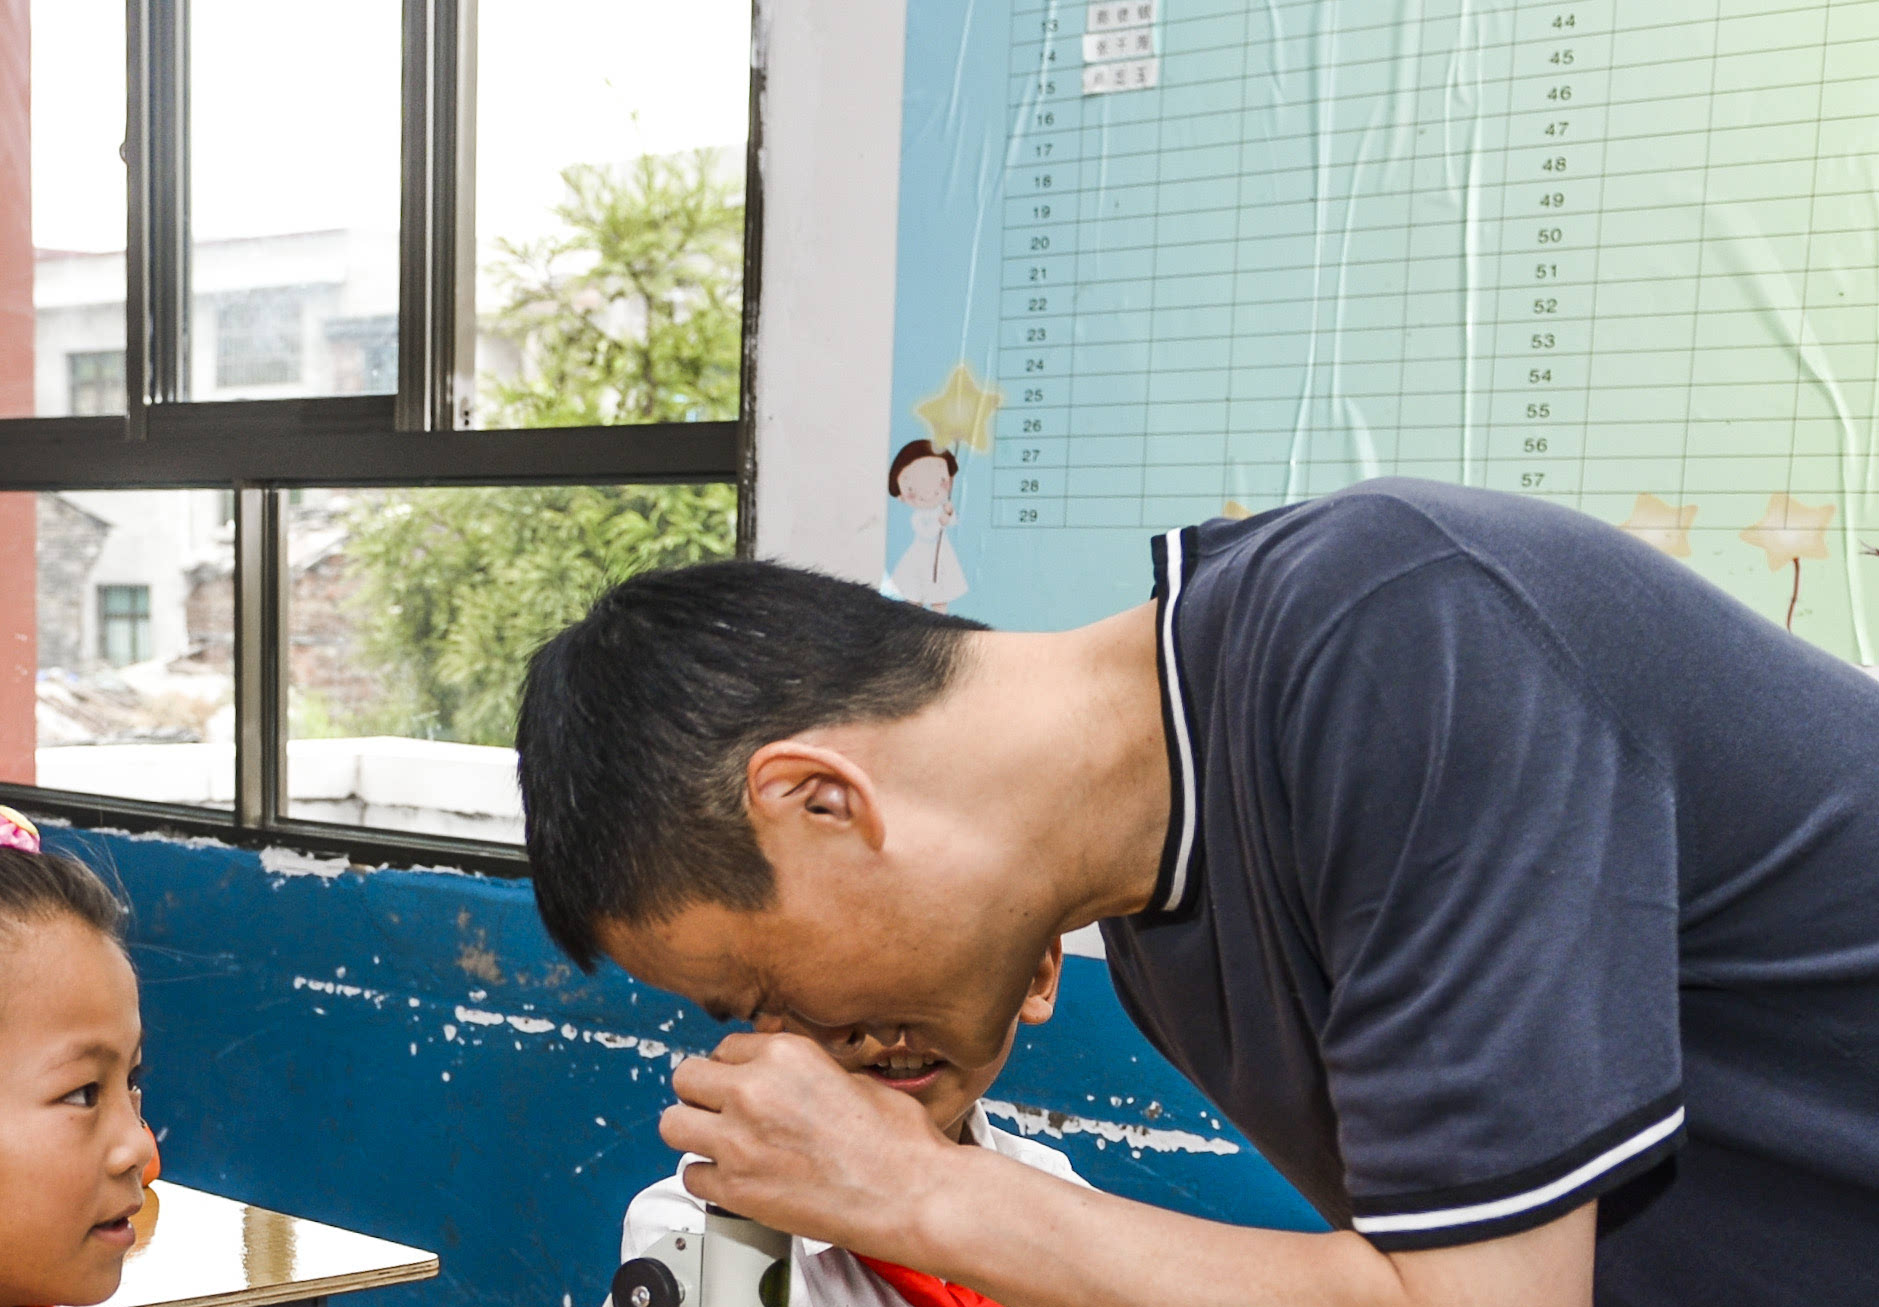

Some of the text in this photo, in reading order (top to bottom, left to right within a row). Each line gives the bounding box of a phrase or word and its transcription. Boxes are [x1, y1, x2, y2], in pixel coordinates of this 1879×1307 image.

[1551, 13, 1577, 30] 44
[1548, 49, 1575, 66] 45
[1546, 85, 1572, 102] 46
[1037, 111, 1055, 127] 16
[1543, 120, 1570, 138] 47
[1035, 142, 1054, 157] 17
[1541, 156, 1567, 173] 48
[1034, 174, 1053, 189] 18
[1539, 192, 1565, 209] 49
[1033, 204, 1051, 219] 19
[1029, 235, 1051, 251] 20
[1537, 227, 1563, 245] 50
[1028, 266, 1047, 282] 21
[1535, 263, 1558, 280] 51
[1027, 297, 1048, 313] 22
[1532, 297, 1558, 315] 52
[1026, 327, 1047, 343] 23
[1530, 332, 1556, 350] 53
[1025, 358, 1045, 373] 24
[1527, 368, 1552, 385] 54
[1023, 388, 1044, 403] 25
[1526, 402, 1551, 419] 55
[1022, 418, 1043, 434] 26
[1523, 437, 1548, 454] 56
[1021, 448, 1041, 463] 27
[1020, 479, 1040, 494] 28
[1520, 472, 1546, 489] 57
[1018, 508, 1039, 523] 29
